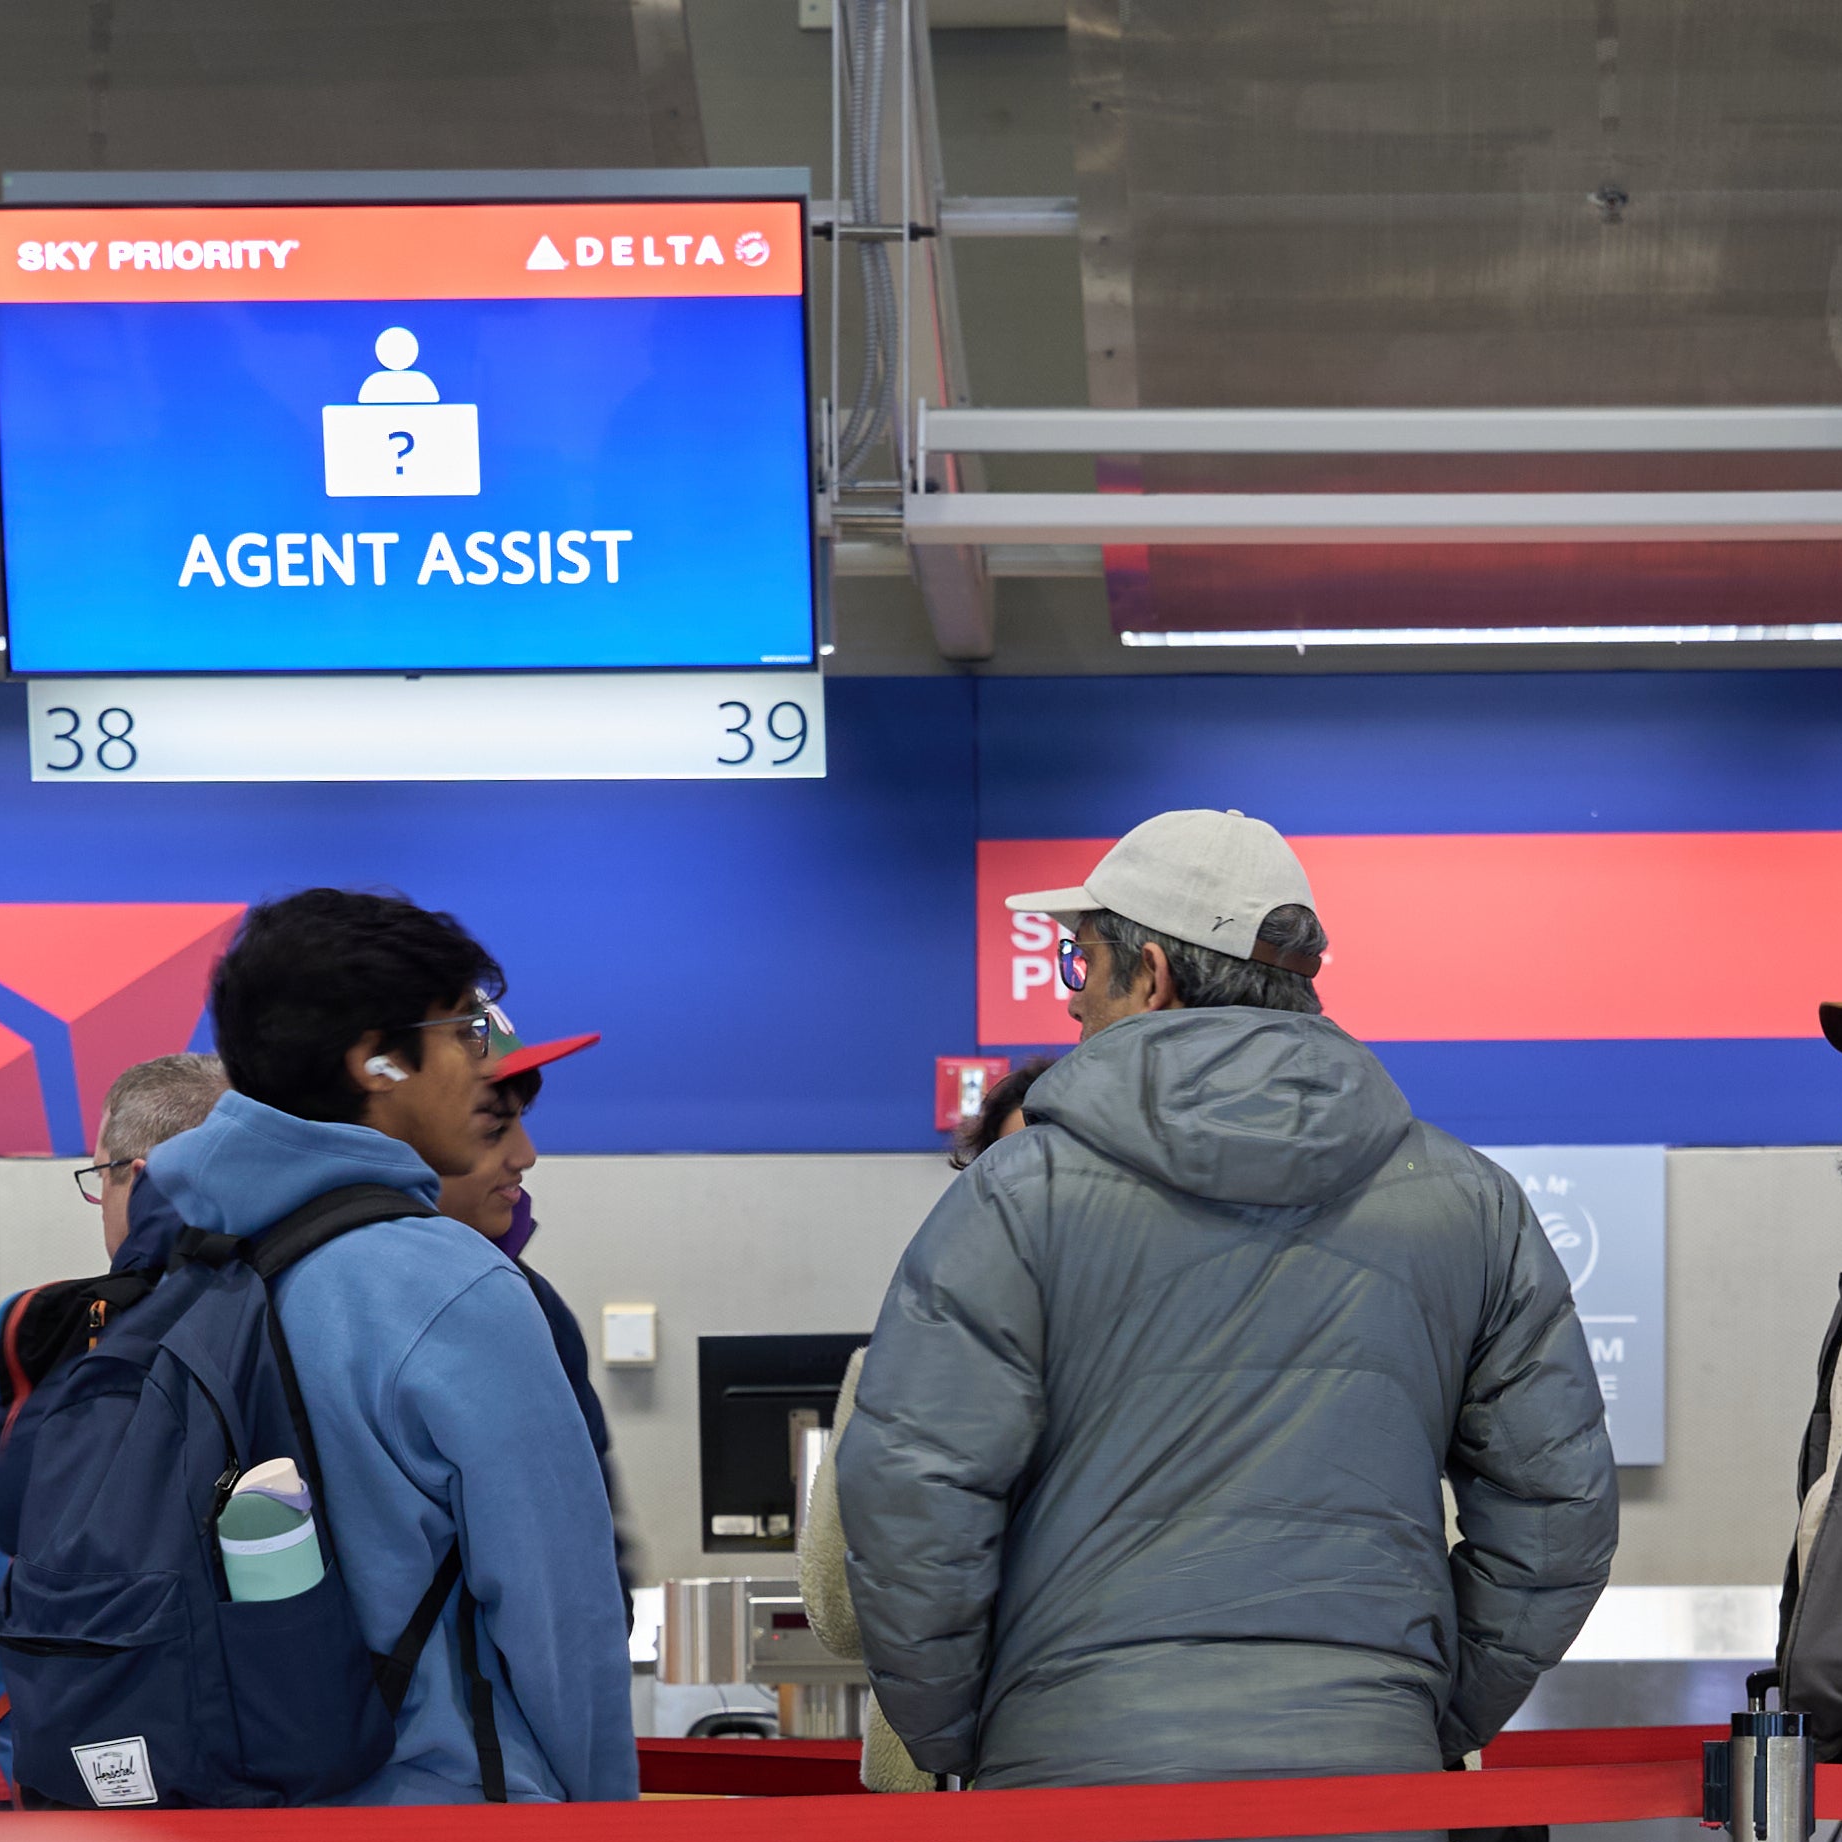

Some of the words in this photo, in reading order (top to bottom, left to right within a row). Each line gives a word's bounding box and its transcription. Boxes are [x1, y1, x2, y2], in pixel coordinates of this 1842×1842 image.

[17, 240, 98, 271] SKY
[108, 239, 296, 270] PRIORITY
[575, 235, 725, 266] DELTA
[178, 532, 399, 587] AGENT
[417, 530, 633, 585] ASSIST
[46, 706, 138, 771] 38
[717, 701, 808, 766] 39
